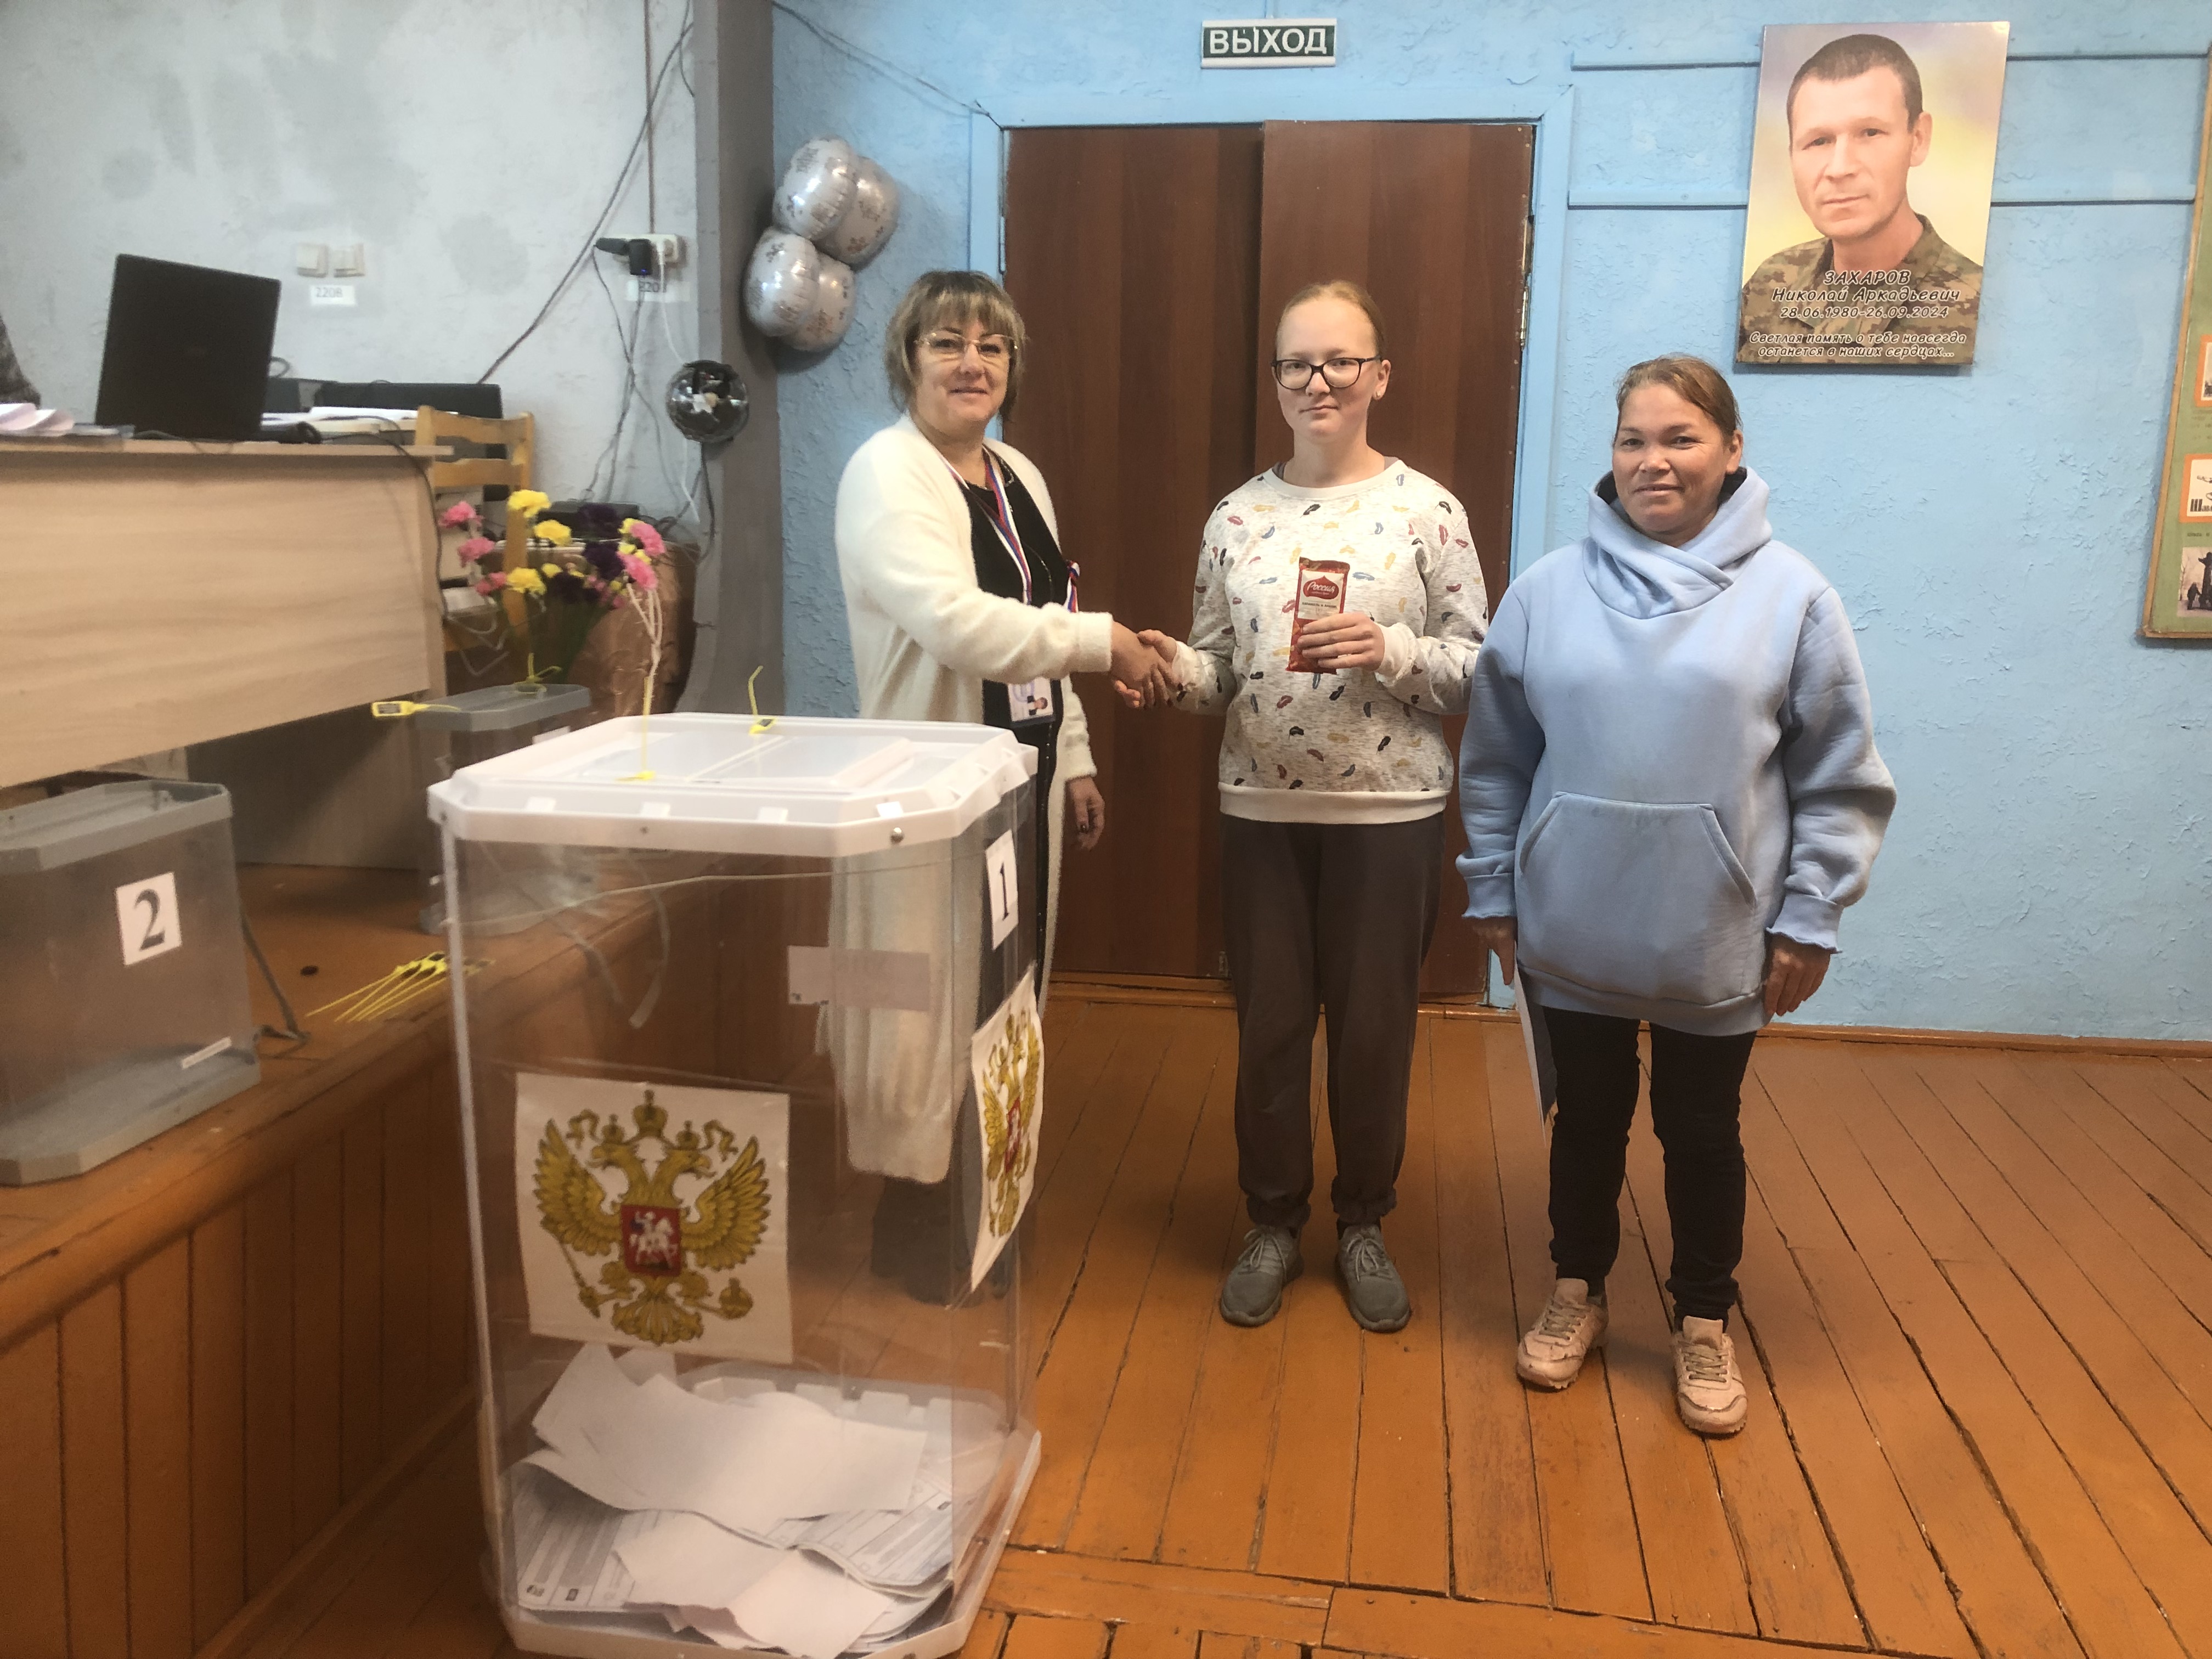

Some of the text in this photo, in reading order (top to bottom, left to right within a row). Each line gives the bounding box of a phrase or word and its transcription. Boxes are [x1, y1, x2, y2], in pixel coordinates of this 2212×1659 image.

[1210, 27, 1327, 54] ВЫХОД
[1824, 270, 1911, 285] ЗАХАРОВ
[1771, 286, 1960, 304] Николай Аркадьевич
[1780, 306, 1949, 318] 28.06.1980-26.09.2024
[1750, 331, 1967, 343] Светлая память о тебе навсегда
[1758, 345, 1954, 359] останется в наших сердцах...
[1307, 582, 1335, 592] Россия
[1000, 861, 1009, 921] 1
[134, 889, 165, 951] 2
